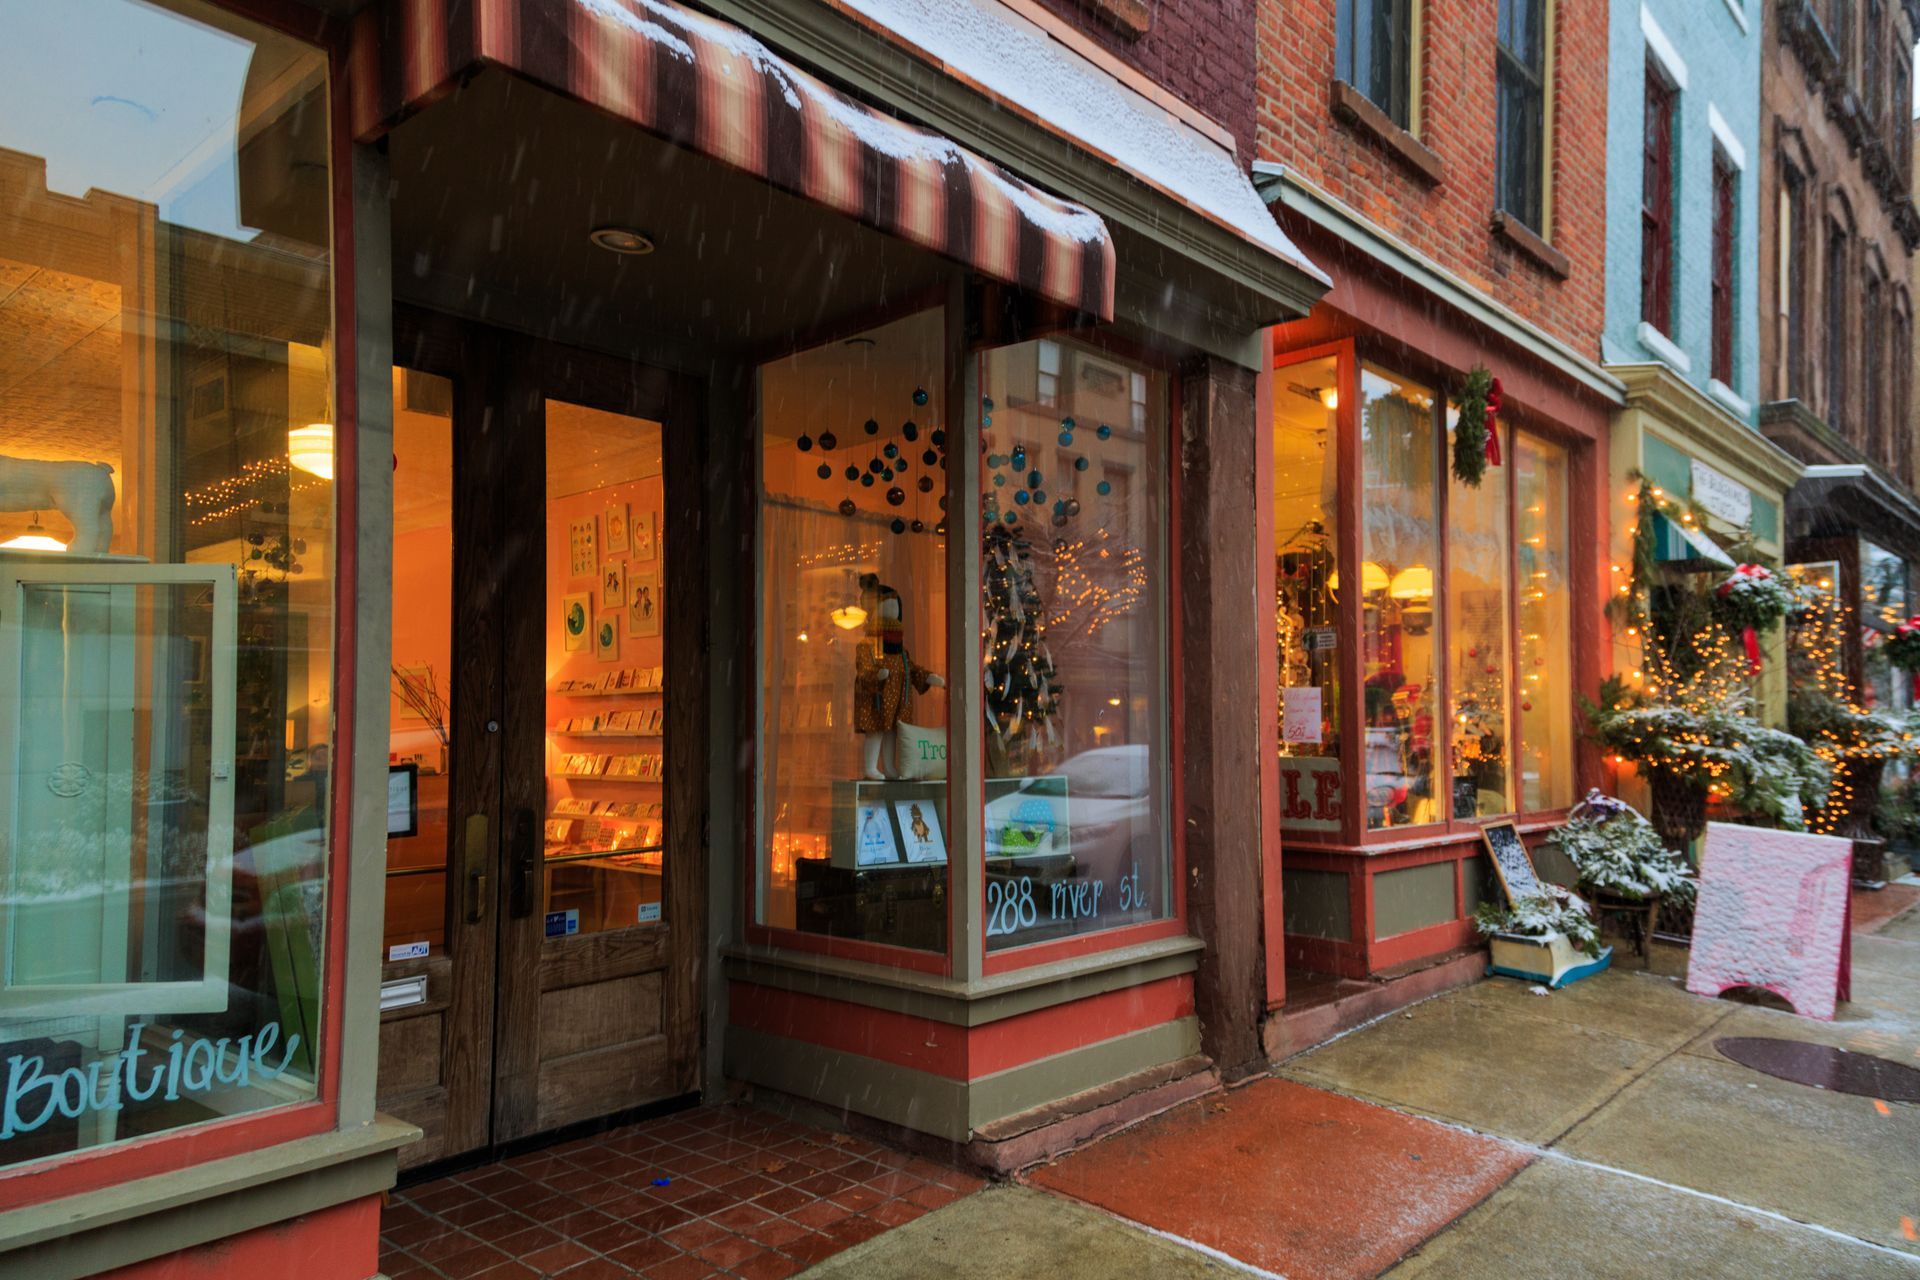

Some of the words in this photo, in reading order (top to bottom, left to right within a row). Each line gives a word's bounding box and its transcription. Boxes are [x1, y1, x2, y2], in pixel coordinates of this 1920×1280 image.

[985, 875, 1037, 937] 288
[1051, 879, 1103, 920] river
[1119, 862, 1148, 912] st.
[0, 1022, 300, 1140] Boutique
